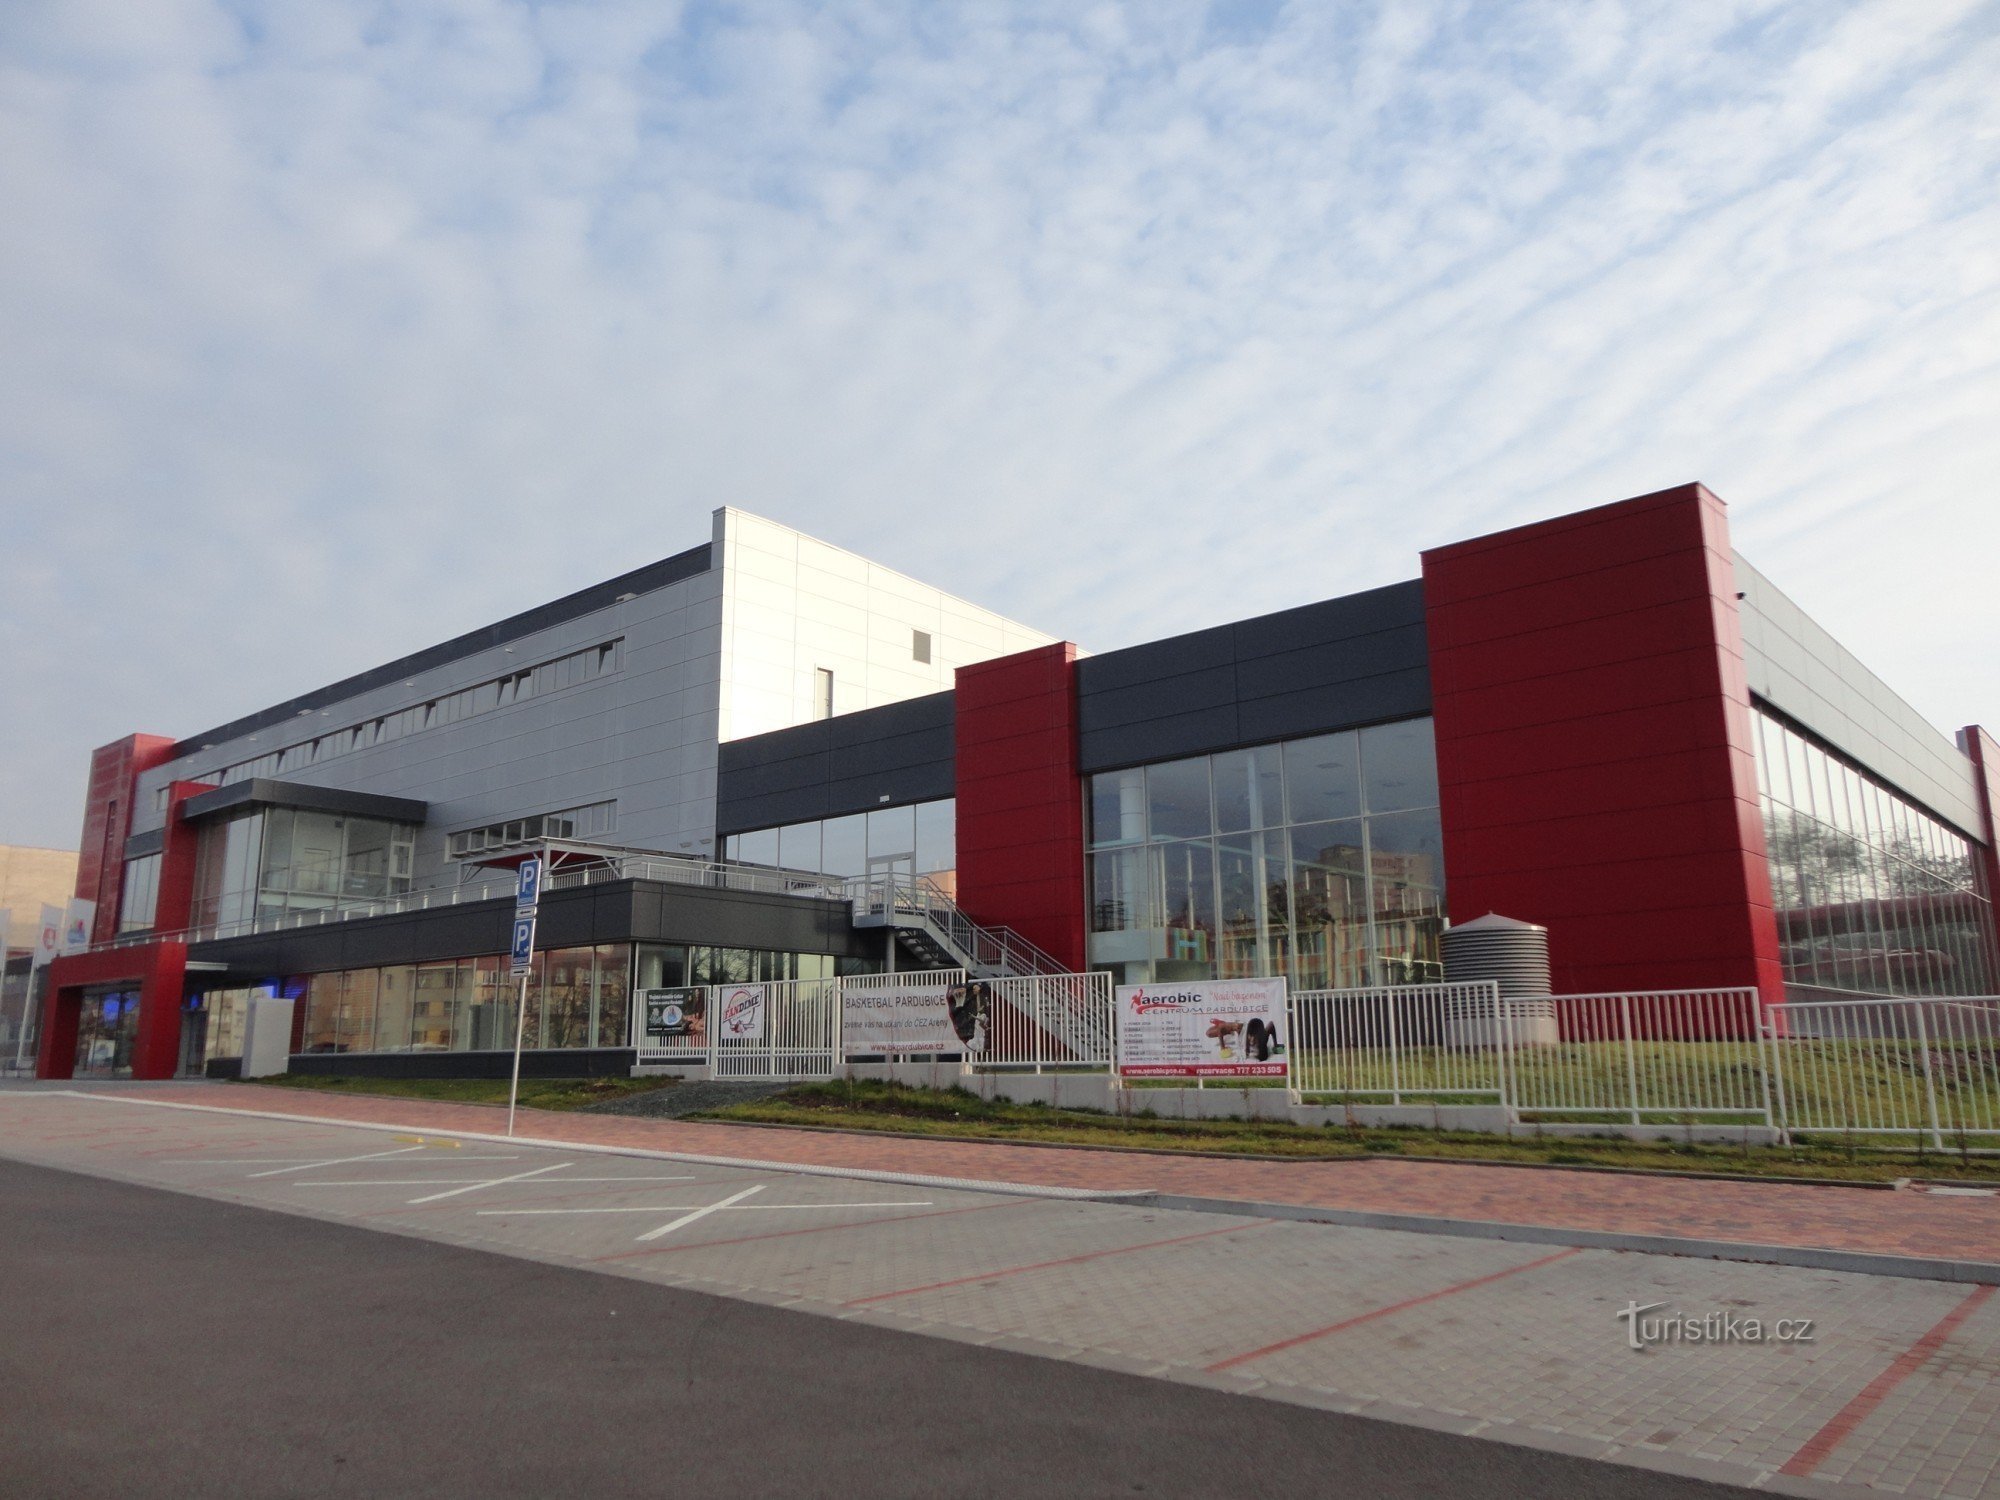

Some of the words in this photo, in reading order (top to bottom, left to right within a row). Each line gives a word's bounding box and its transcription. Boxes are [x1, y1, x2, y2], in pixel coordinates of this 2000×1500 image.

[522, 866, 535, 893] P
[516, 924, 529, 952] P
[845, 997, 893, 1009] BASKETBAL
[895, 995, 945, 1007] PARDUBICE
[1142, 992, 1202, 1005] aerobic
[1143, 1007, 1204, 1015] CENTRUM
[1206, 1004, 1269, 1013] PARDUBICE
[904, 1018, 913, 1028] do
[870, 1043, 945, 1053] www.bkpardubice.cz
[1236, 1066, 1251, 1074] 777
[1251, 1066, 1267, 1074] 233
[1267, 1065, 1282, 1074] 505
